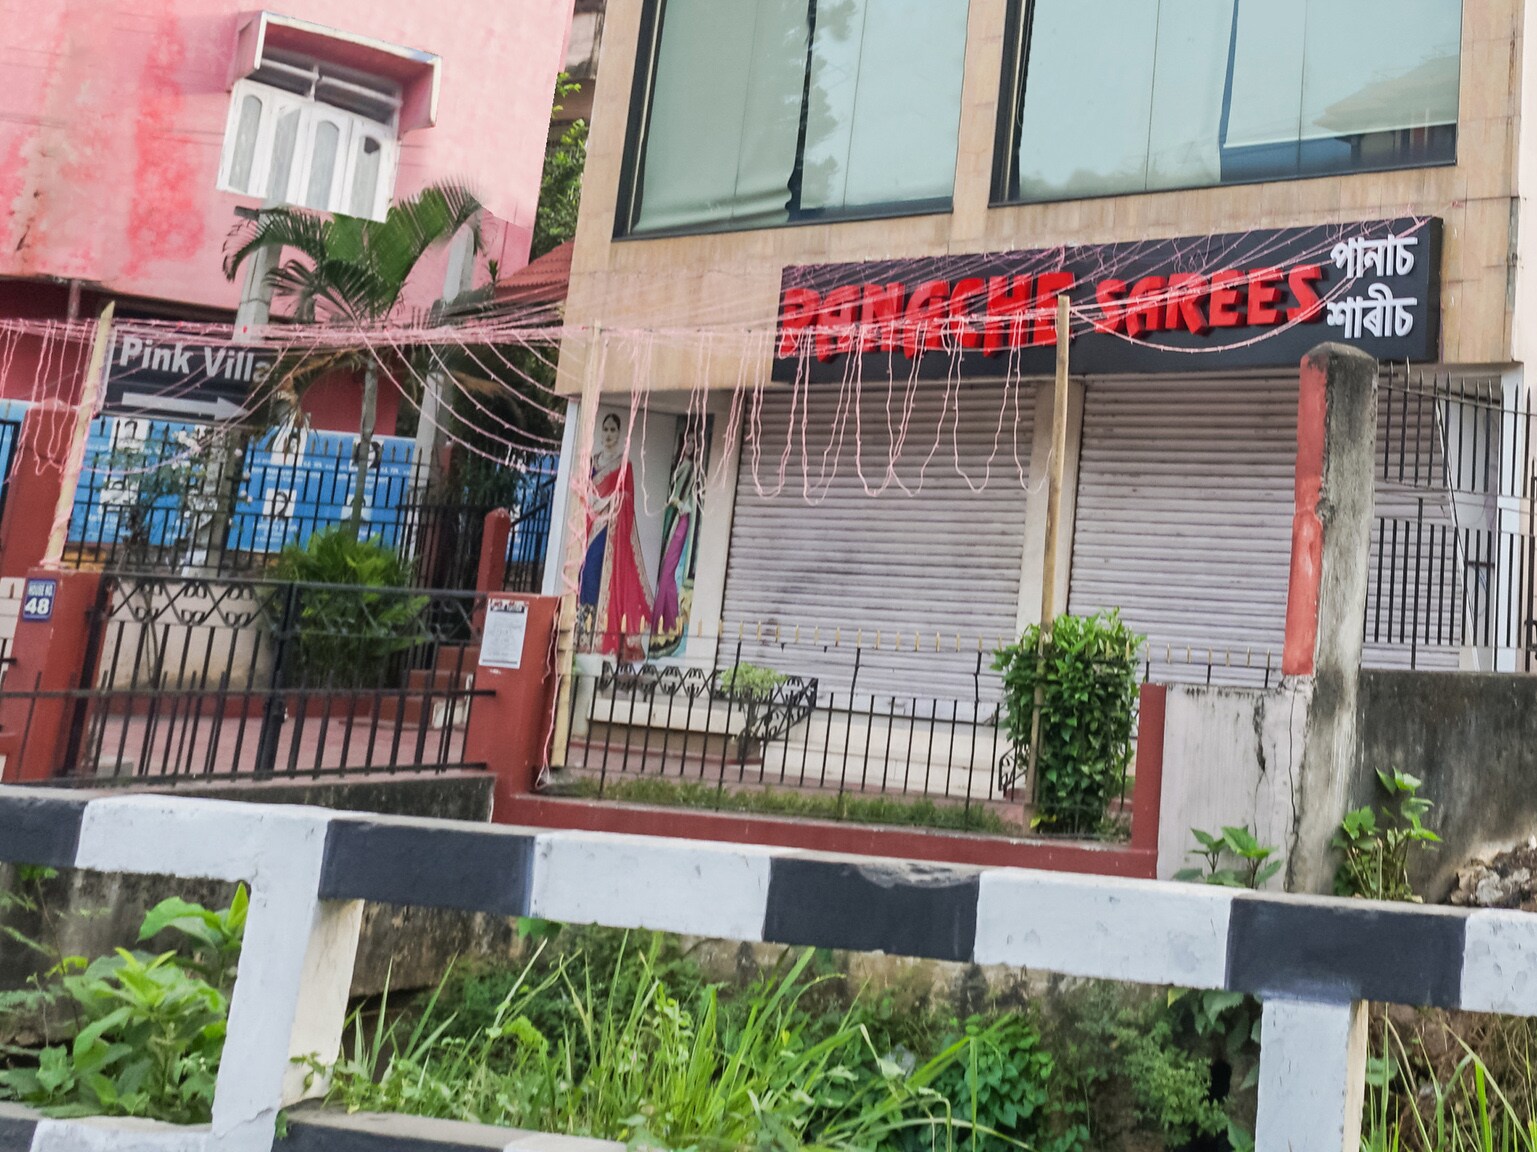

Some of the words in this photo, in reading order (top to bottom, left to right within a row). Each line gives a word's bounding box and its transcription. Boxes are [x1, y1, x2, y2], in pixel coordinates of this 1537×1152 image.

[1094, 264, 1324, 339] SAREES
[119, 335, 194, 375] Pink
[24, 597, 50, 615] 48
